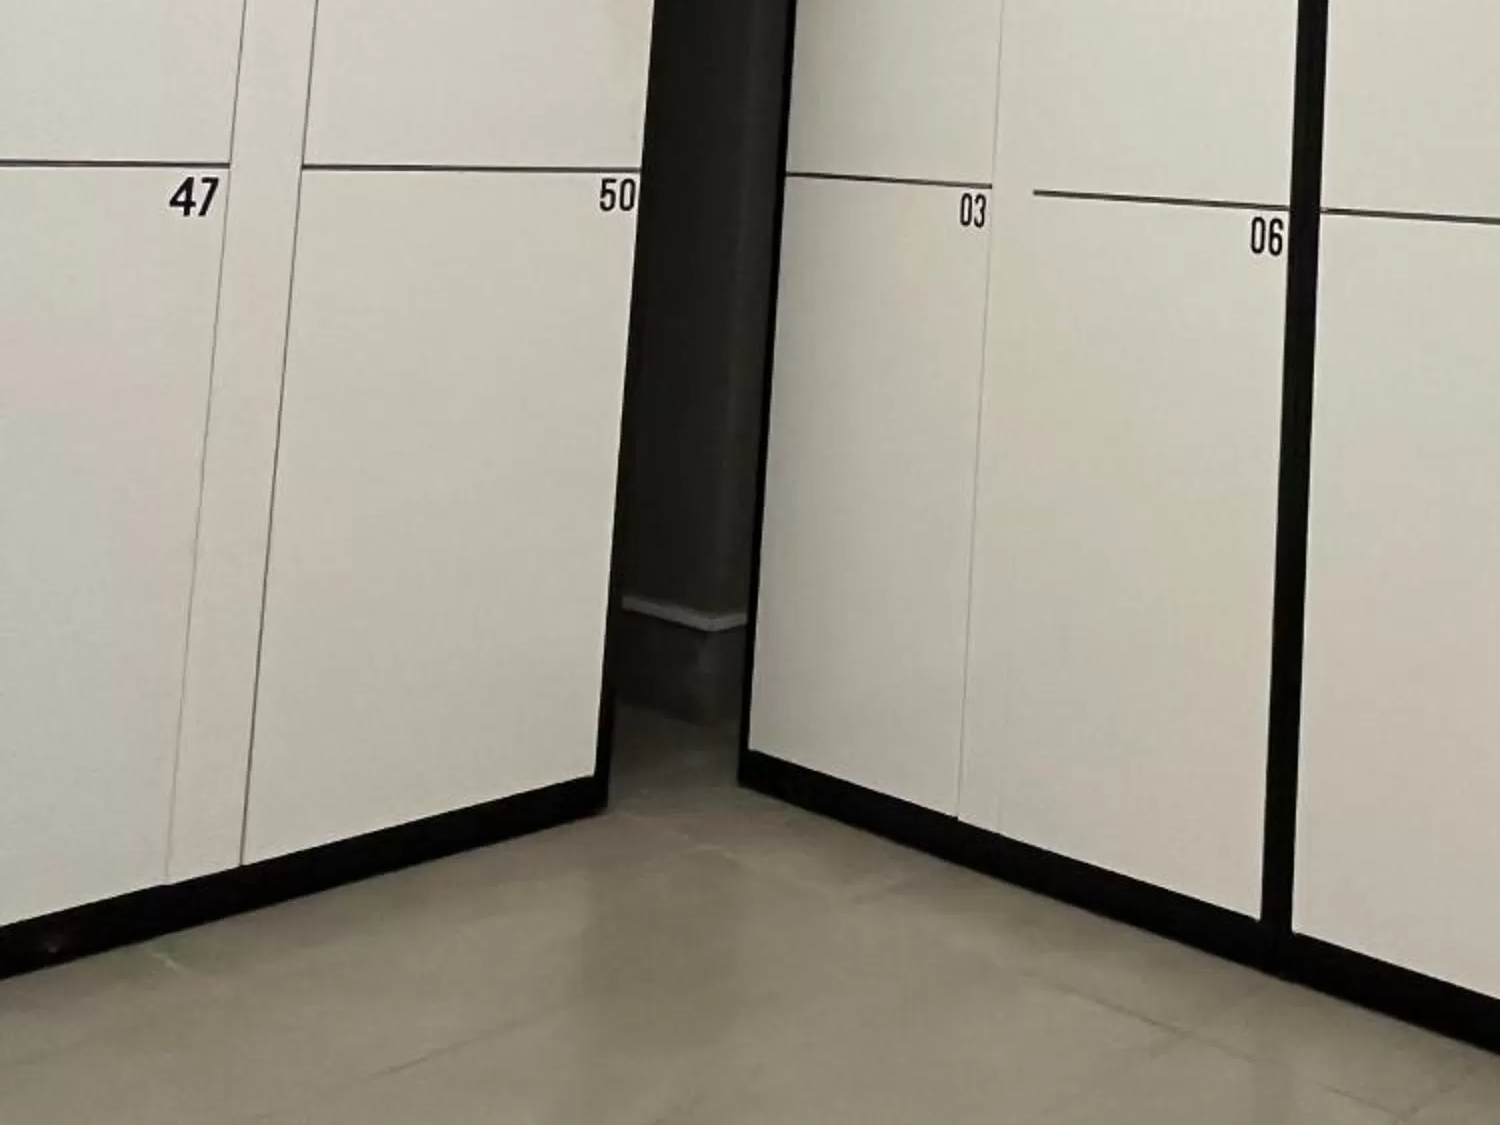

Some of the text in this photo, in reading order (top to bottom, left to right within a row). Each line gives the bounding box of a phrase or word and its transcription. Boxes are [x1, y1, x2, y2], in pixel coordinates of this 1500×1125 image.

[169, 177, 219, 216] 47
[599, 178, 636, 212] 50
[960, 193, 987, 228] 03
[1251, 217, 1284, 256] 06
